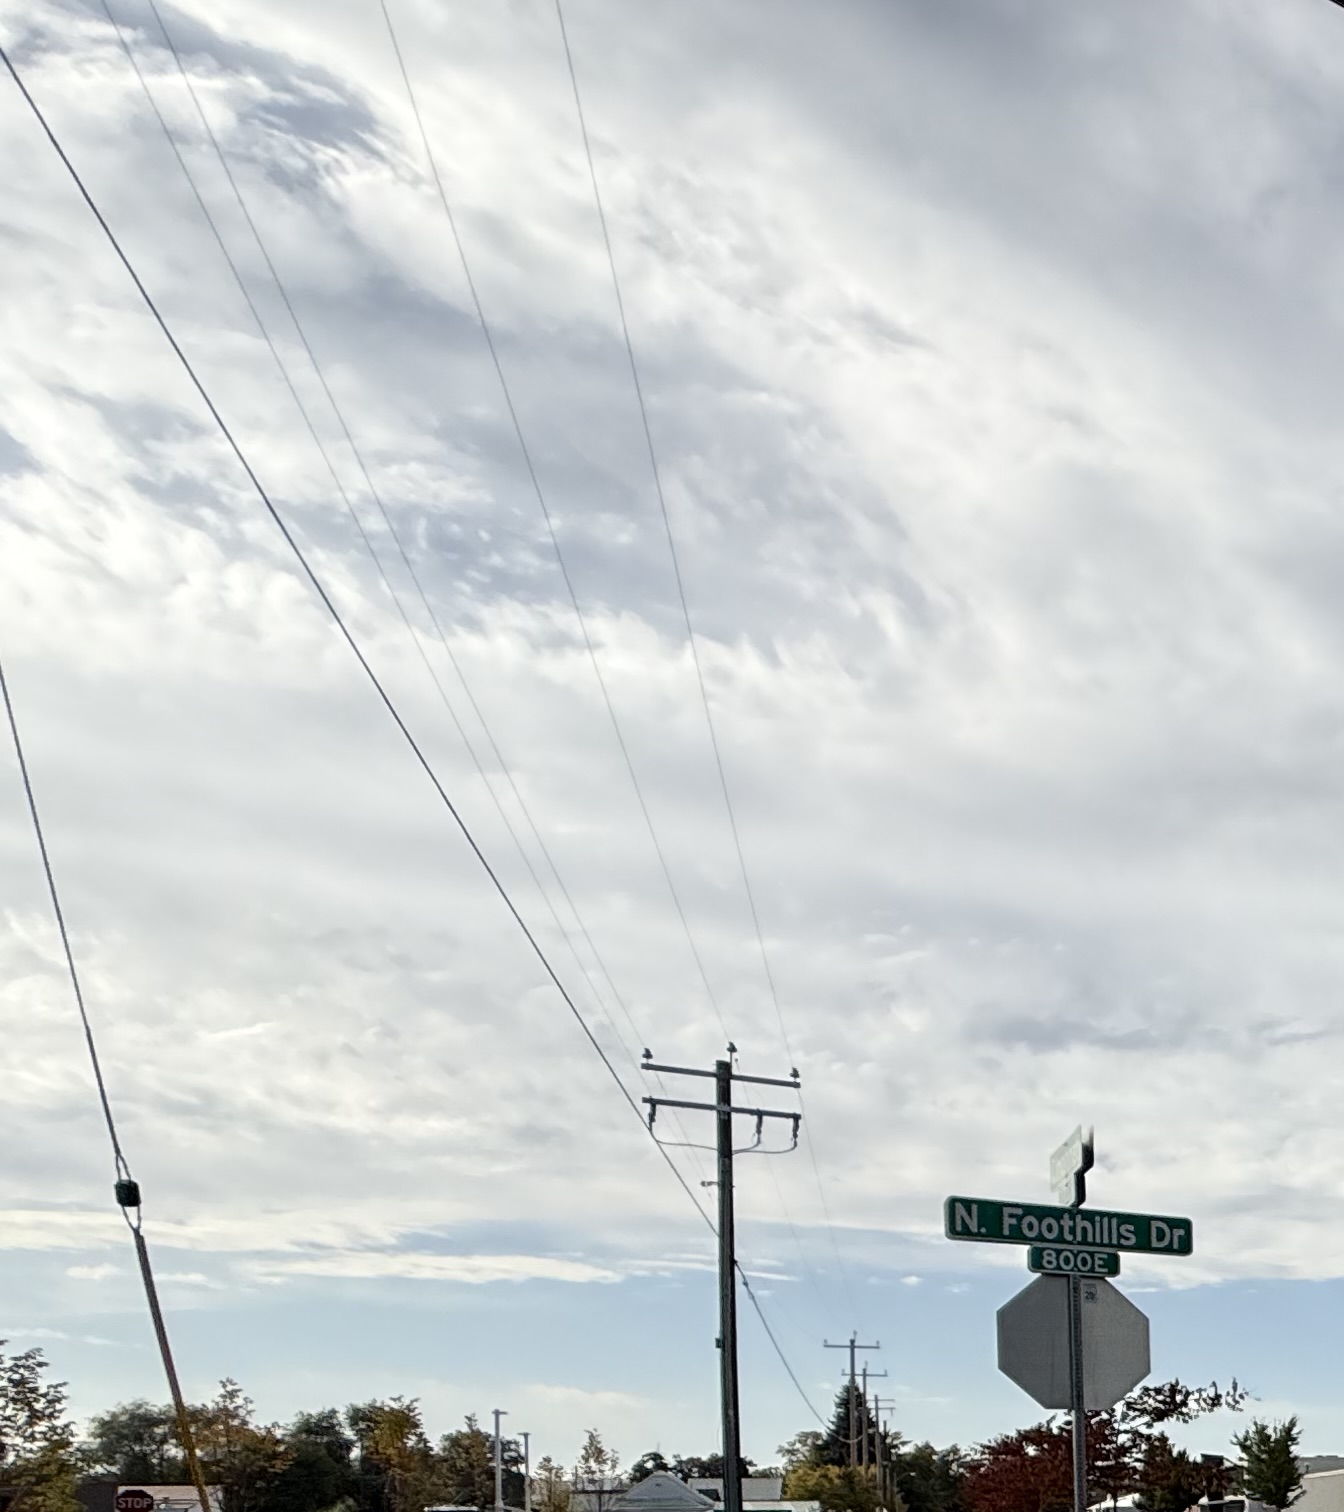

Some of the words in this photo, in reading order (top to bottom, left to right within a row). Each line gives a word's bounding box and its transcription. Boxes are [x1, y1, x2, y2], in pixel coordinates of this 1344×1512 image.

[954, 1203, 986, 1234] N.
[1003, 1207, 1136, 1246] Foothills
[1150, 1223, 1185, 1249] Dr
[117, 1497, 152, 1508] STOP
